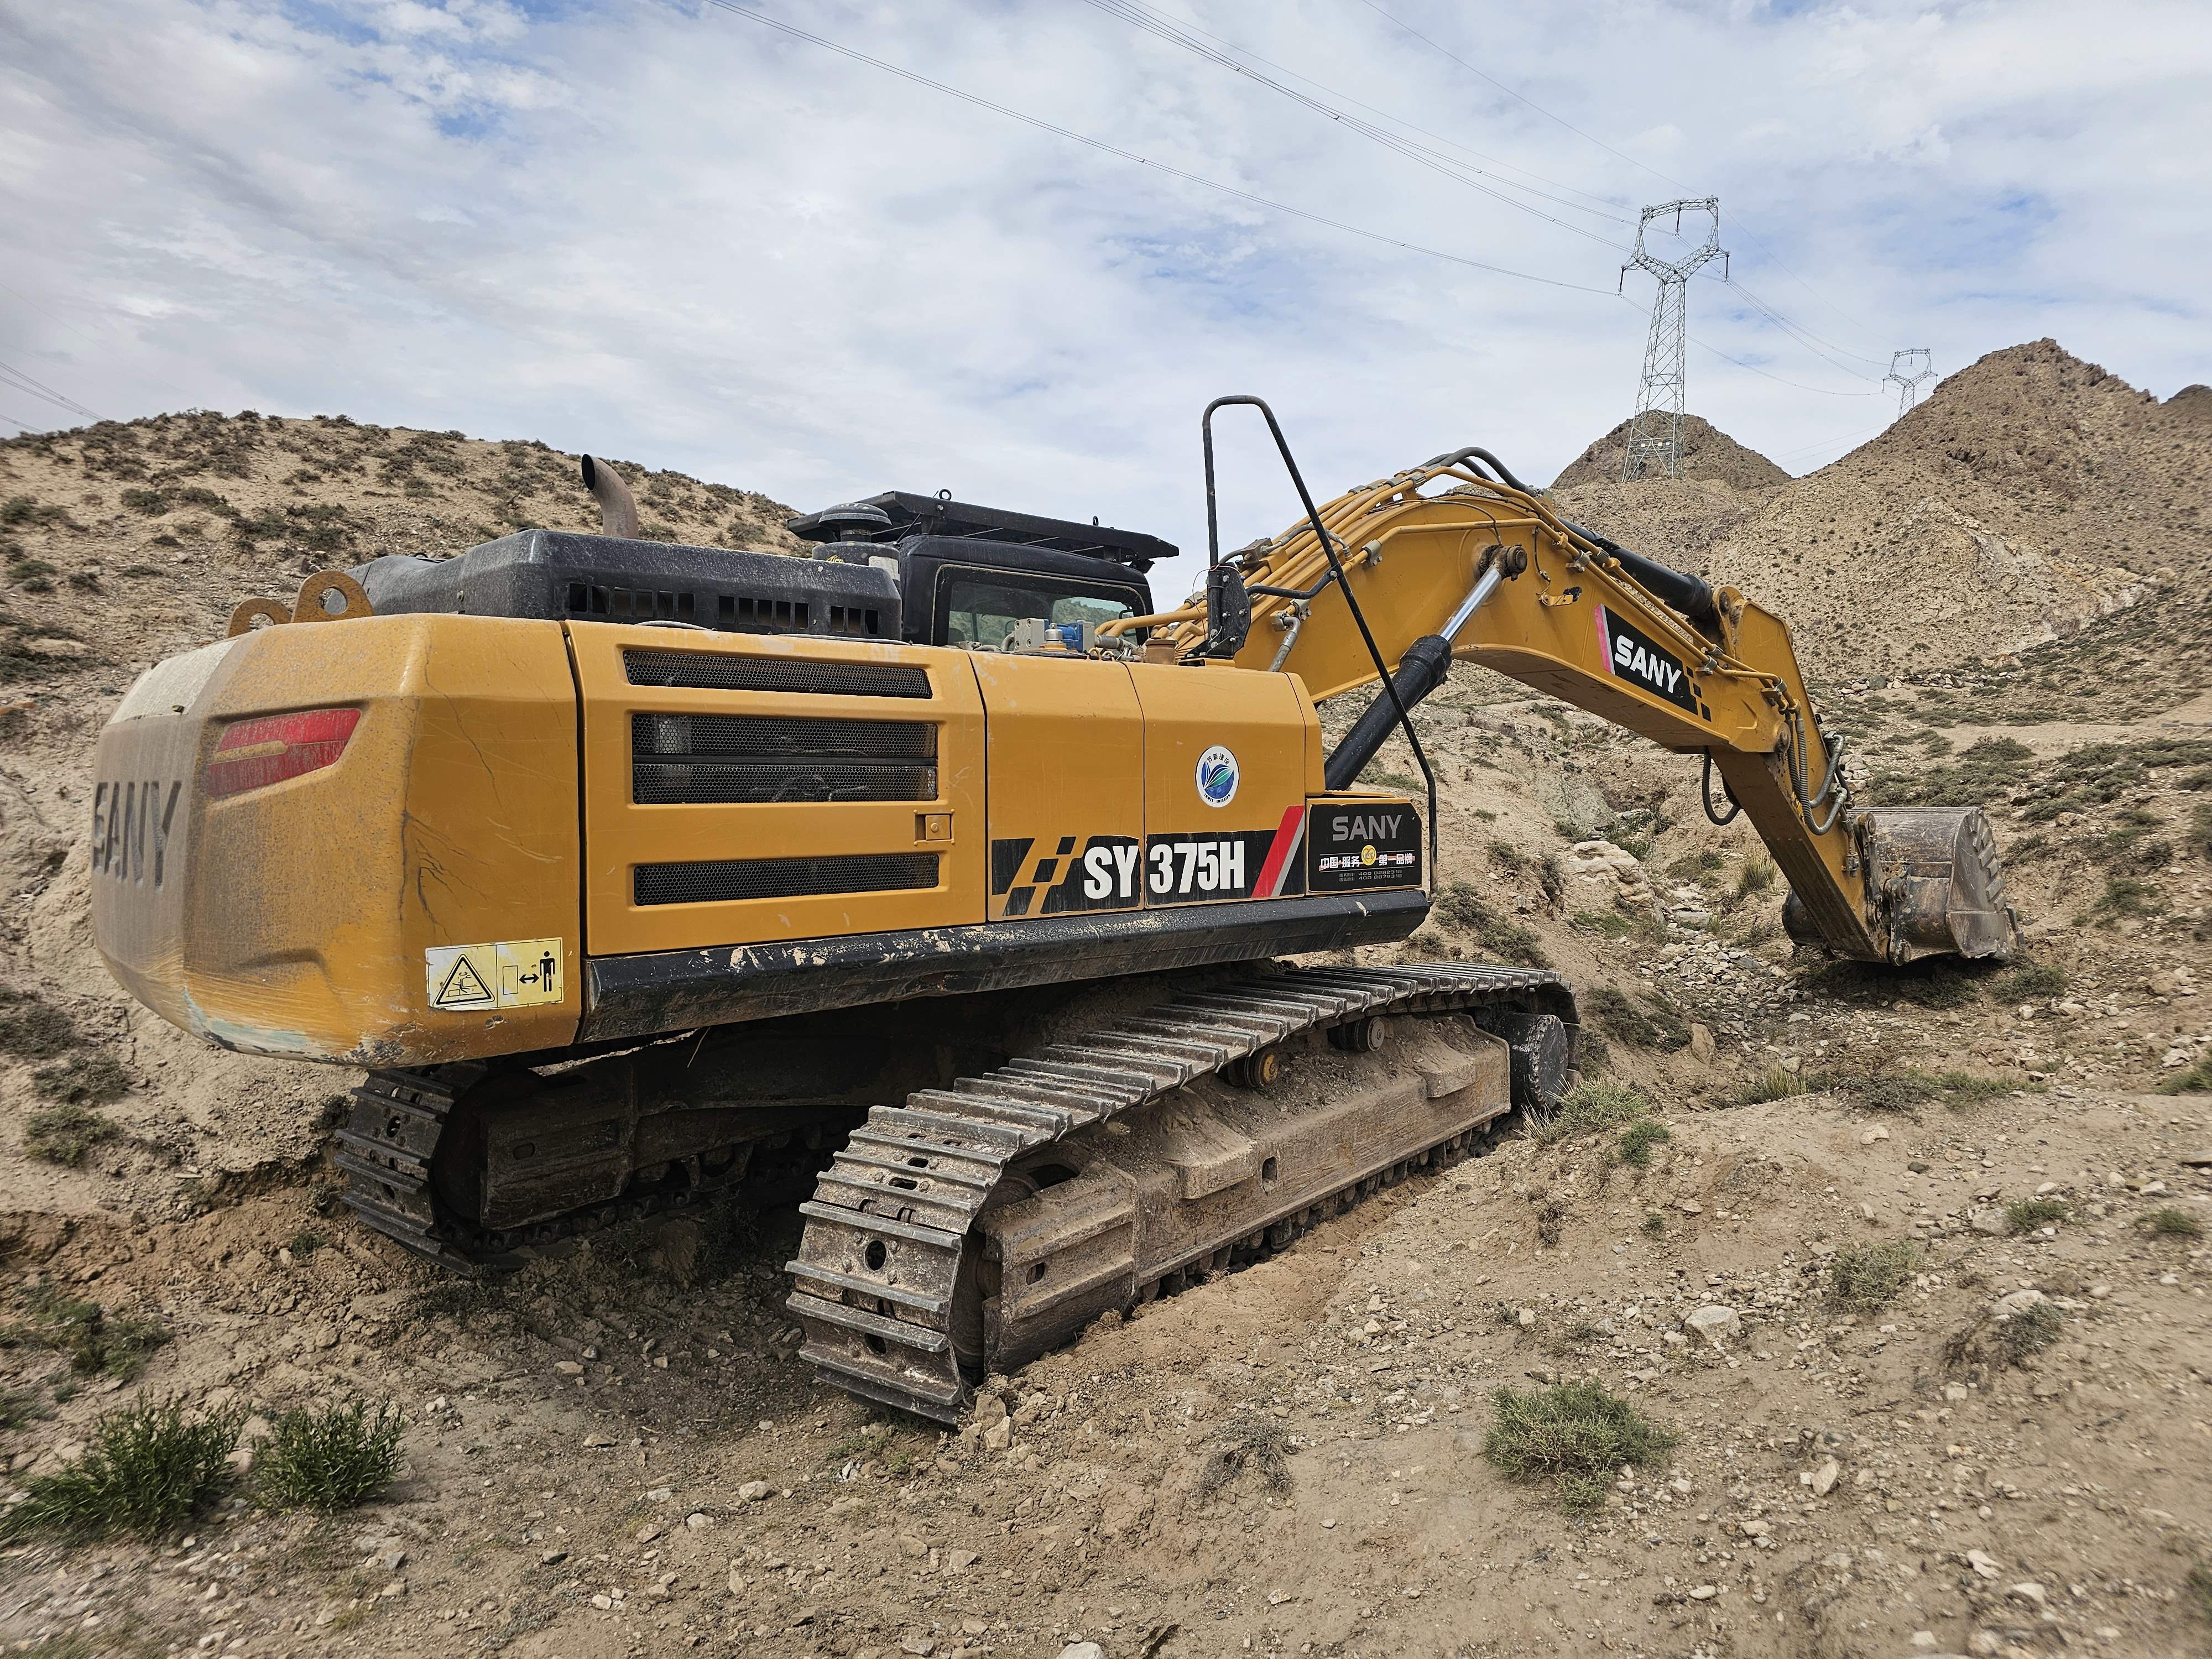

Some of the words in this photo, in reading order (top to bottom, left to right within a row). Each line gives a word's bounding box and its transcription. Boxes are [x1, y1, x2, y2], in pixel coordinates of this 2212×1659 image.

[1614, 635, 1682, 693] SANY
[92, 781, 182, 893] SANY
[1332, 815, 1402, 841] SANY
[1083, 845, 1139, 899] SY
[1149, 841, 1245, 894] 375H
[1379, 853, 1413, 866] 第一品牌
